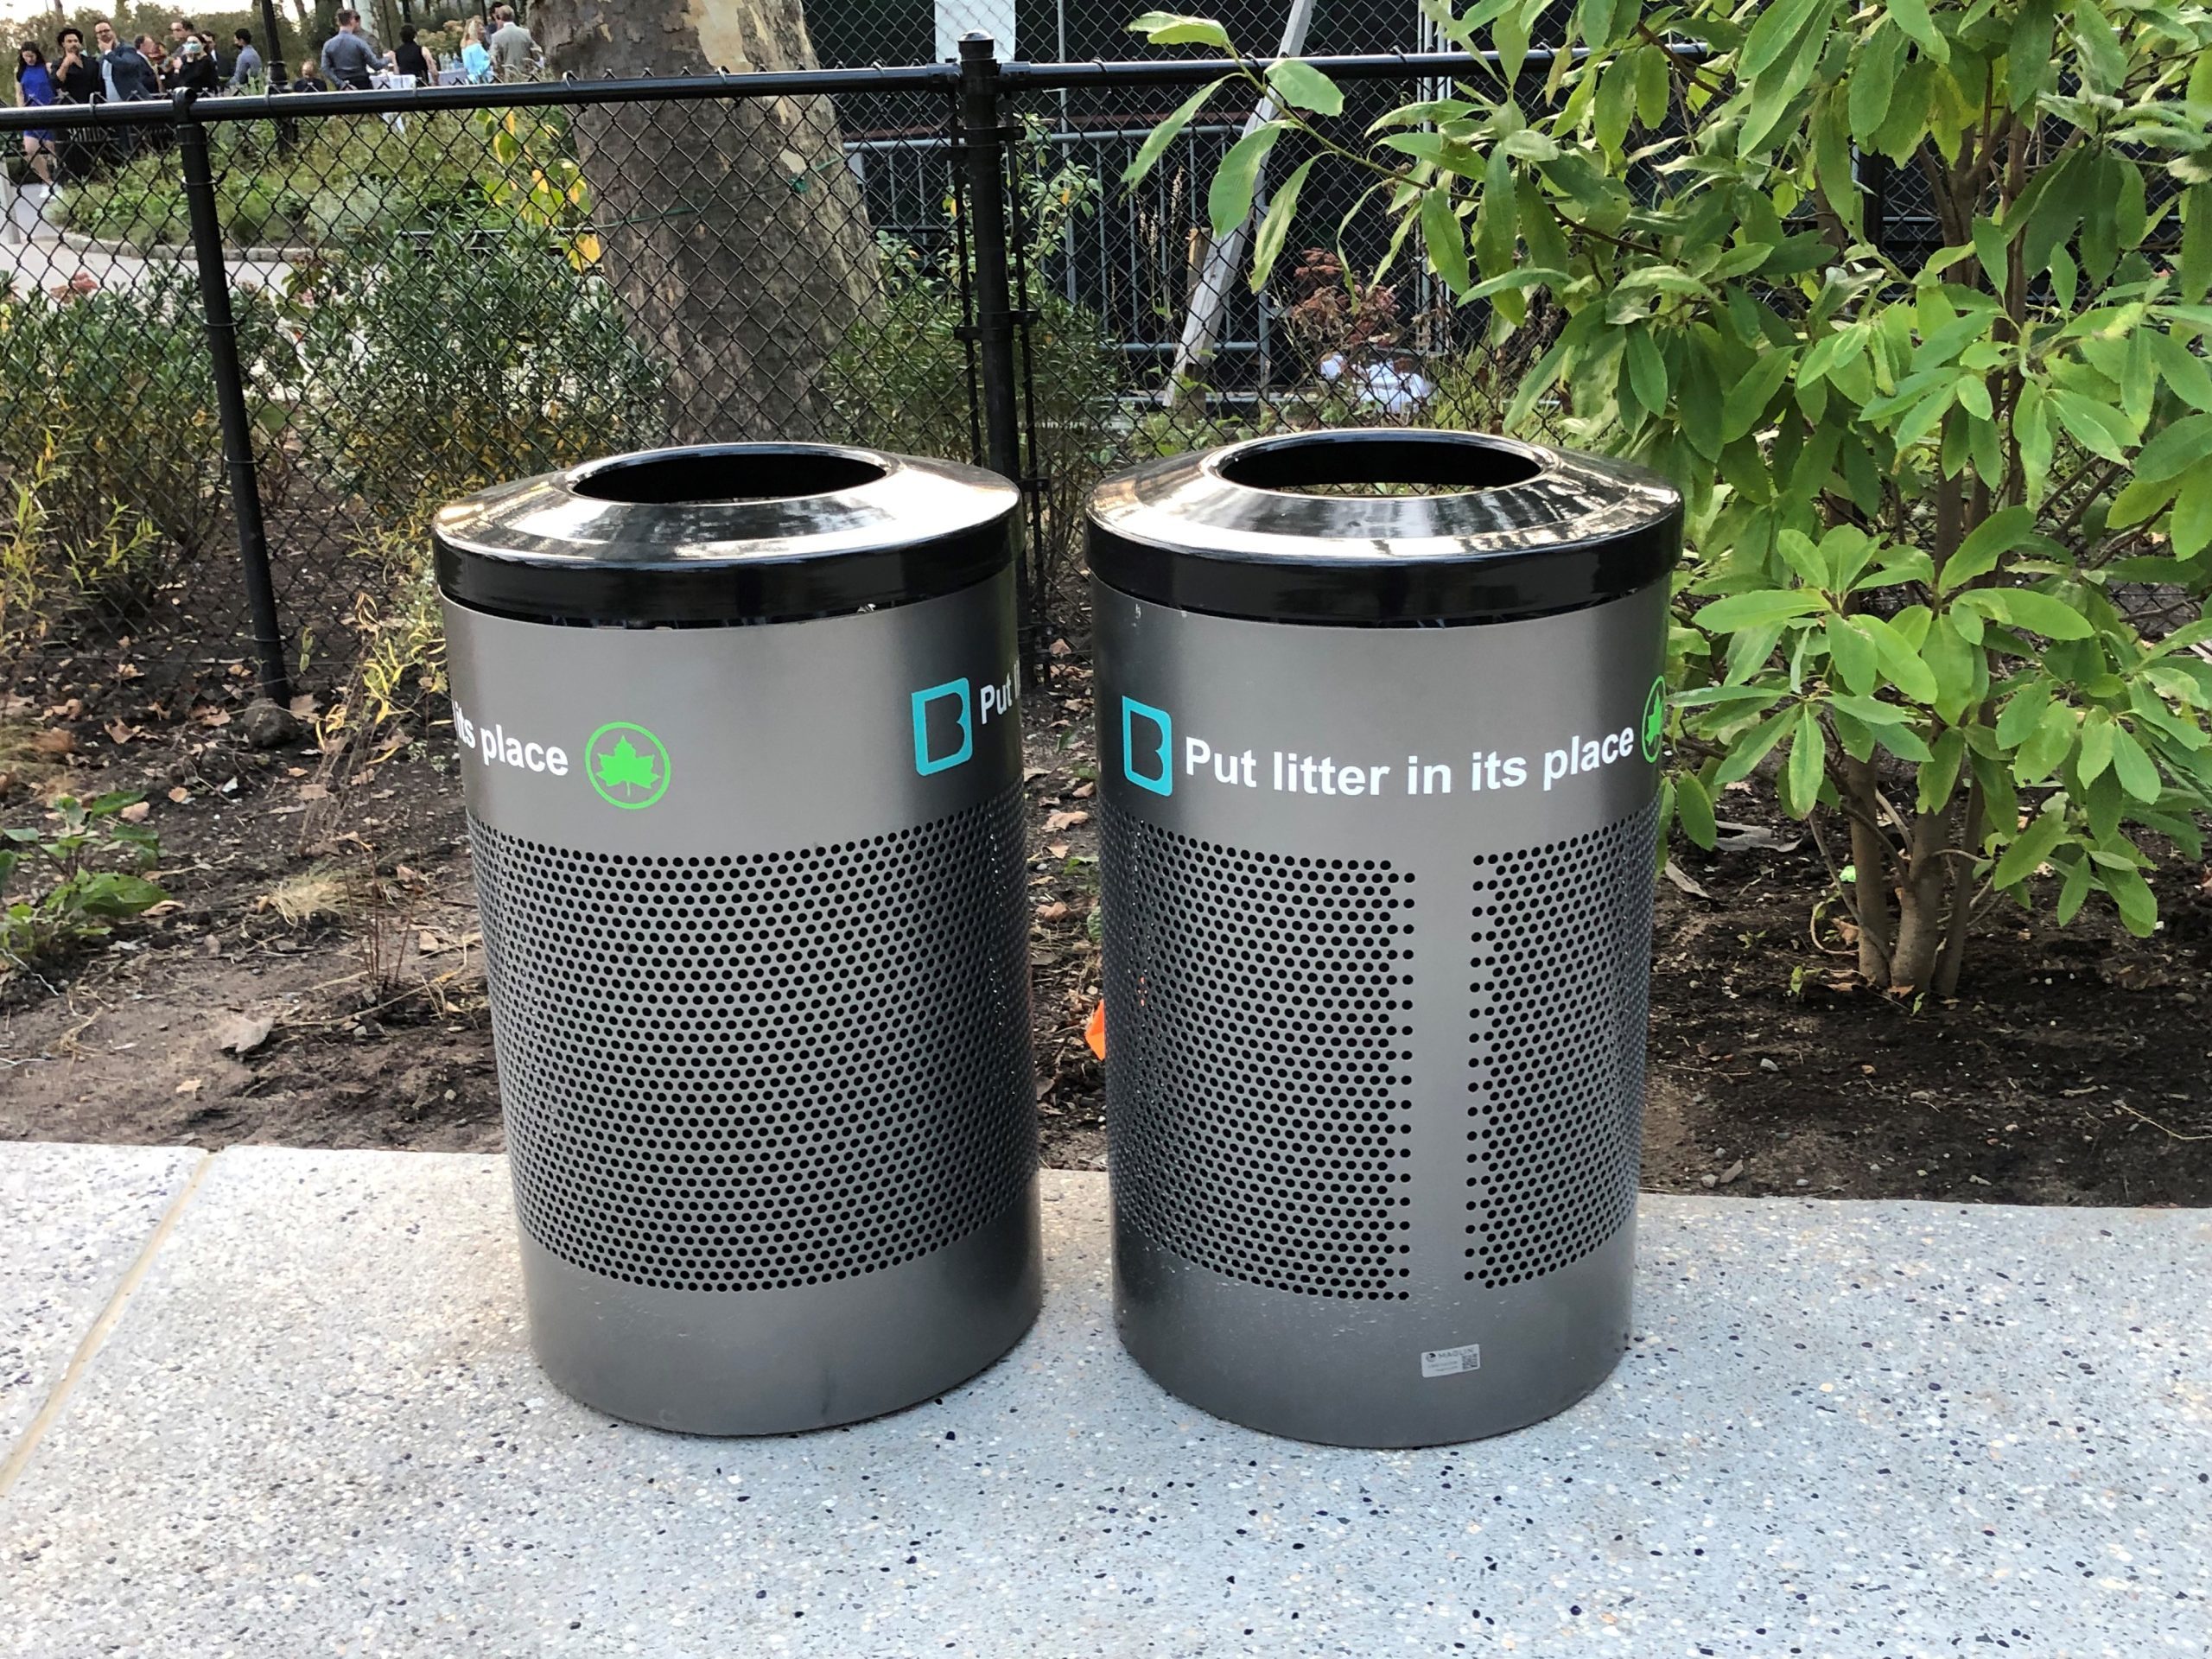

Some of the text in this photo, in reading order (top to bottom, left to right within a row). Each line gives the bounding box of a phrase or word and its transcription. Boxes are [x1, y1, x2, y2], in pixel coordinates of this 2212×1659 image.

[980, 672, 1013, 725] Put
[454, 700, 476, 749] its
[480, 723, 569, 776] place
[1185, 736, 1257, 788] Put
[1273, 751, 1391, 796] litter
[1407, 755, 1452, 795] in
[1471, 751, 1528, 791] its
[1543, 726, 1634, 791] place
